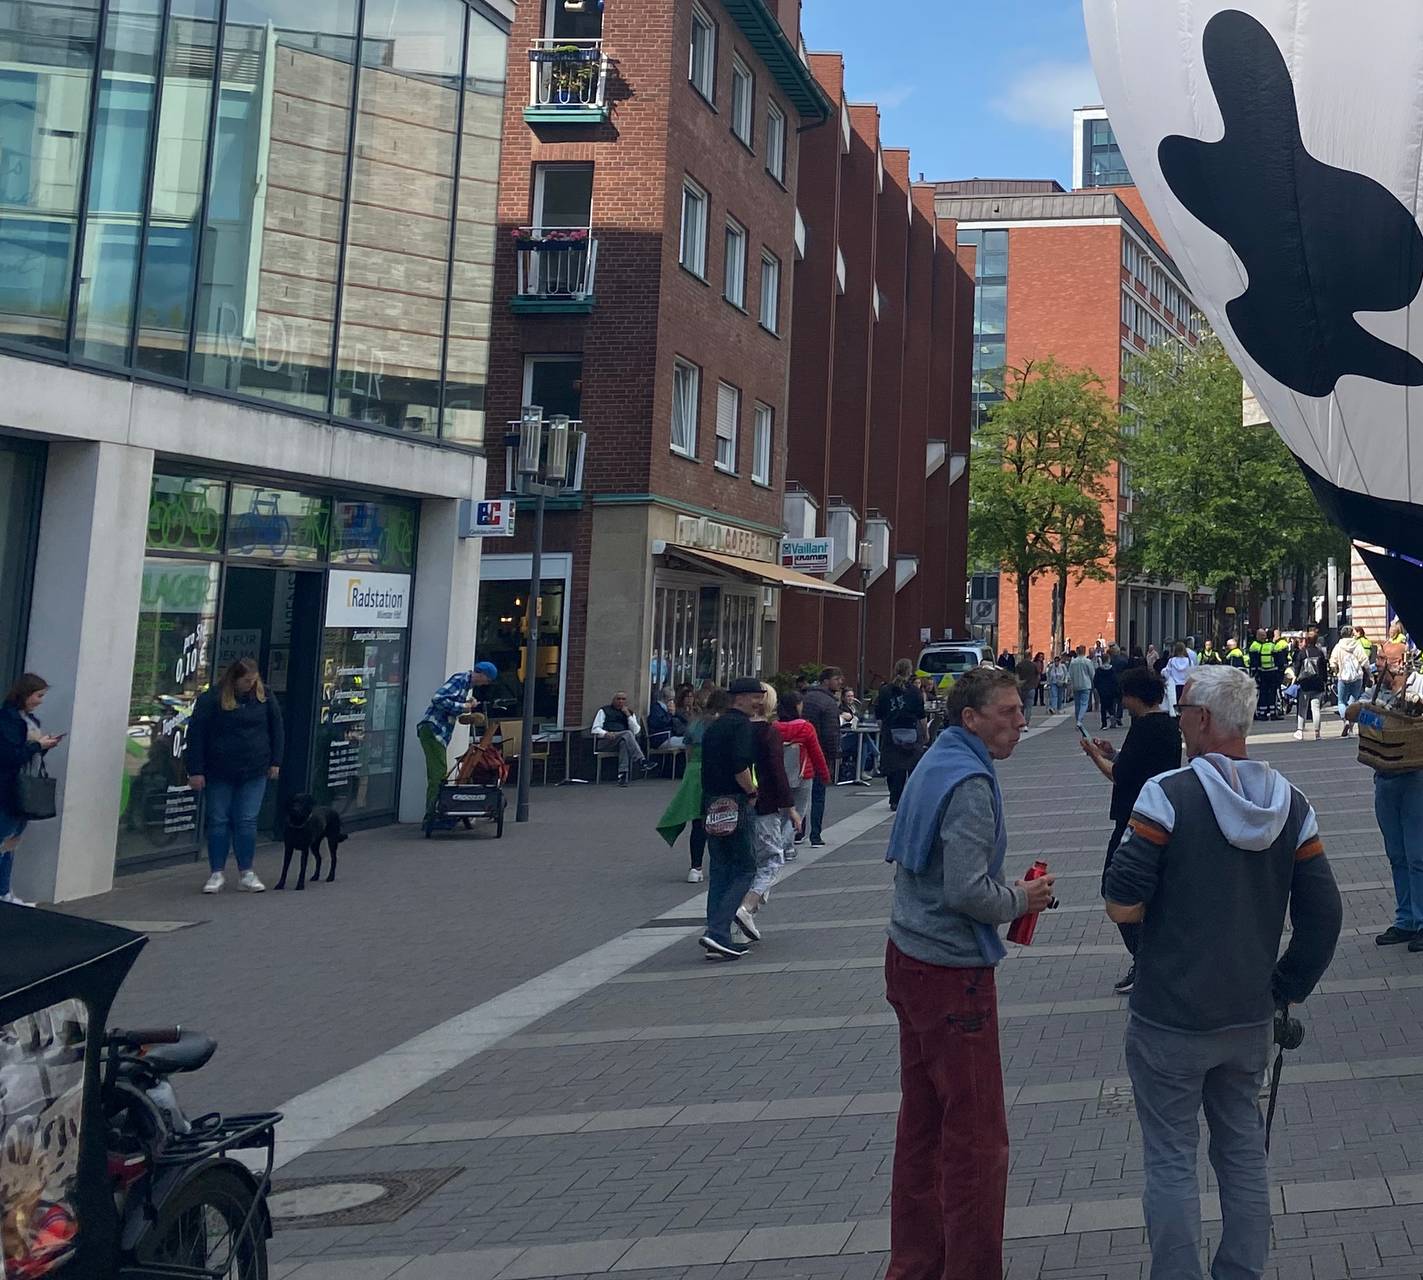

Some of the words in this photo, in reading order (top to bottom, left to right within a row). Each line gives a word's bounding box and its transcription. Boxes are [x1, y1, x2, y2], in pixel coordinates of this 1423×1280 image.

[725, 527, 760, 555] COFFEE
[791, 542, 828, 555] Vaillant
[352, 586, 403, 608] Radstation
